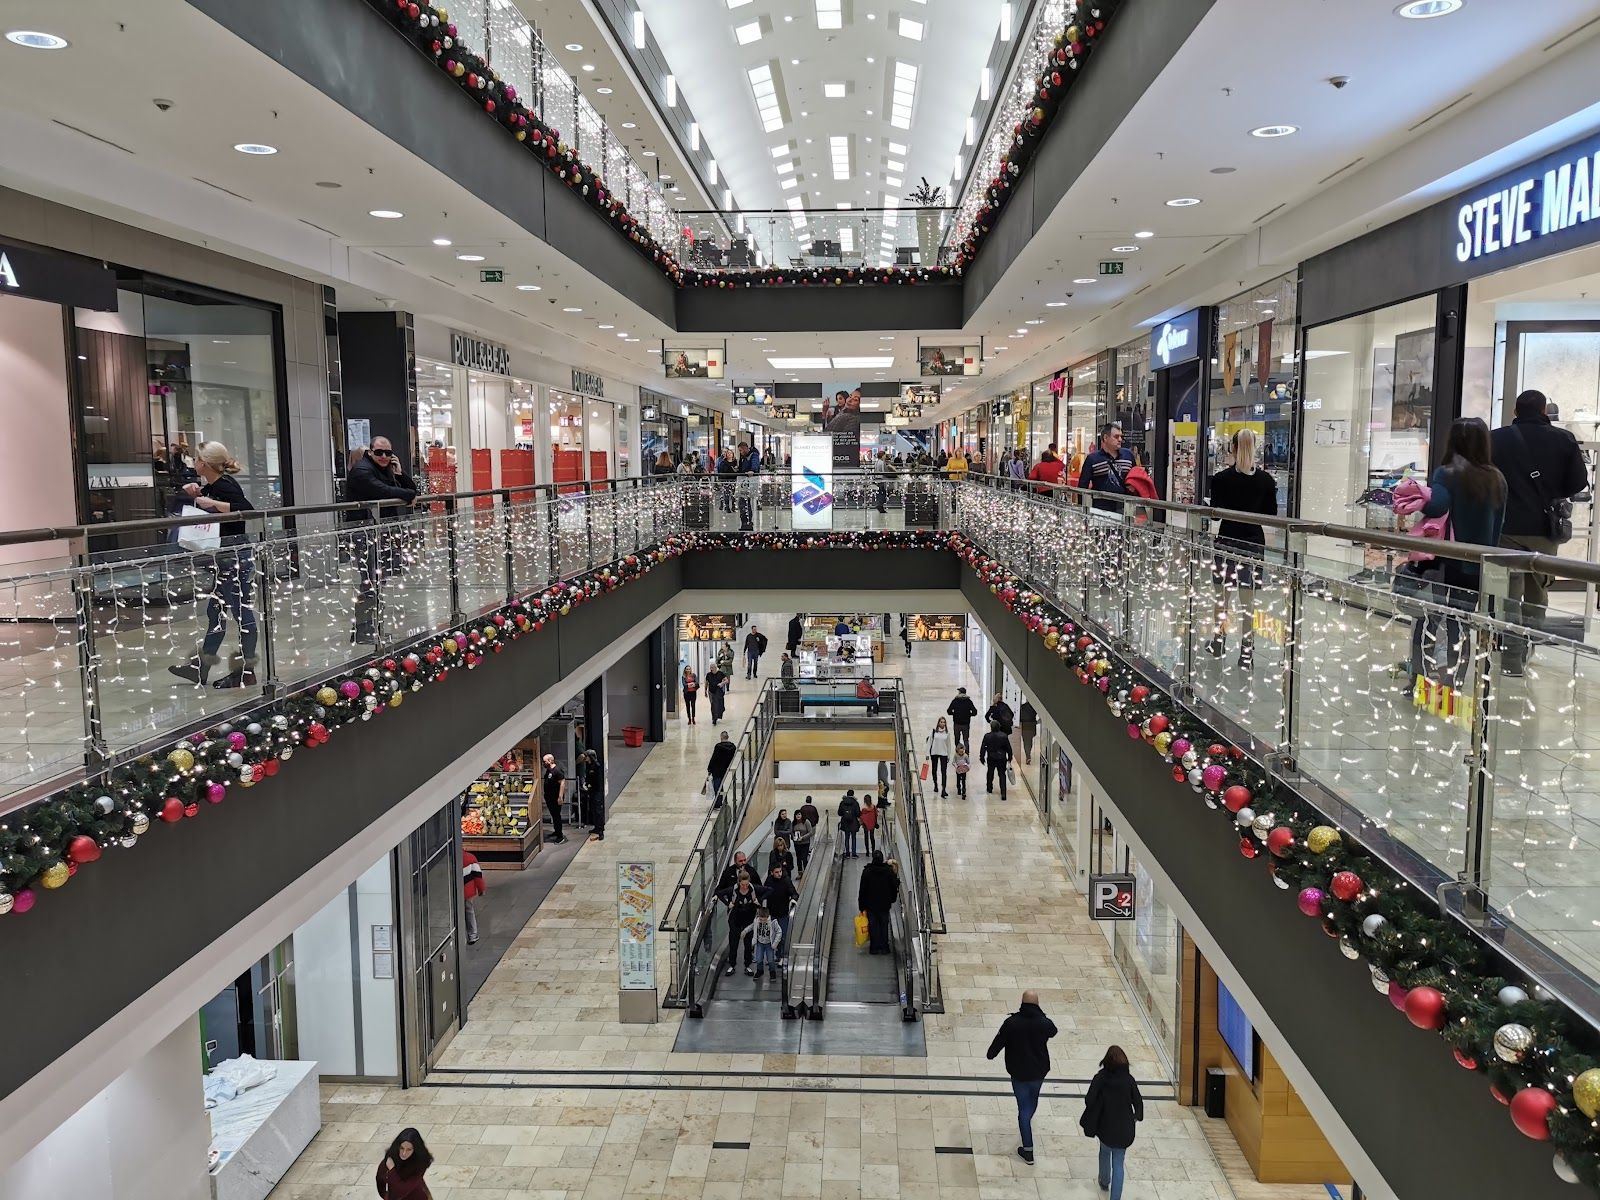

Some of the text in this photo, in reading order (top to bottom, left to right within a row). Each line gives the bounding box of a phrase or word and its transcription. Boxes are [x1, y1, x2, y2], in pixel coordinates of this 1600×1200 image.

[1456, 179, 1534, 262] STEVE
[454, 334, 511, 376] PULL&BEAR
[90, 475, 120, 489] ZARA
[1096, 883, 1119, 909] P
